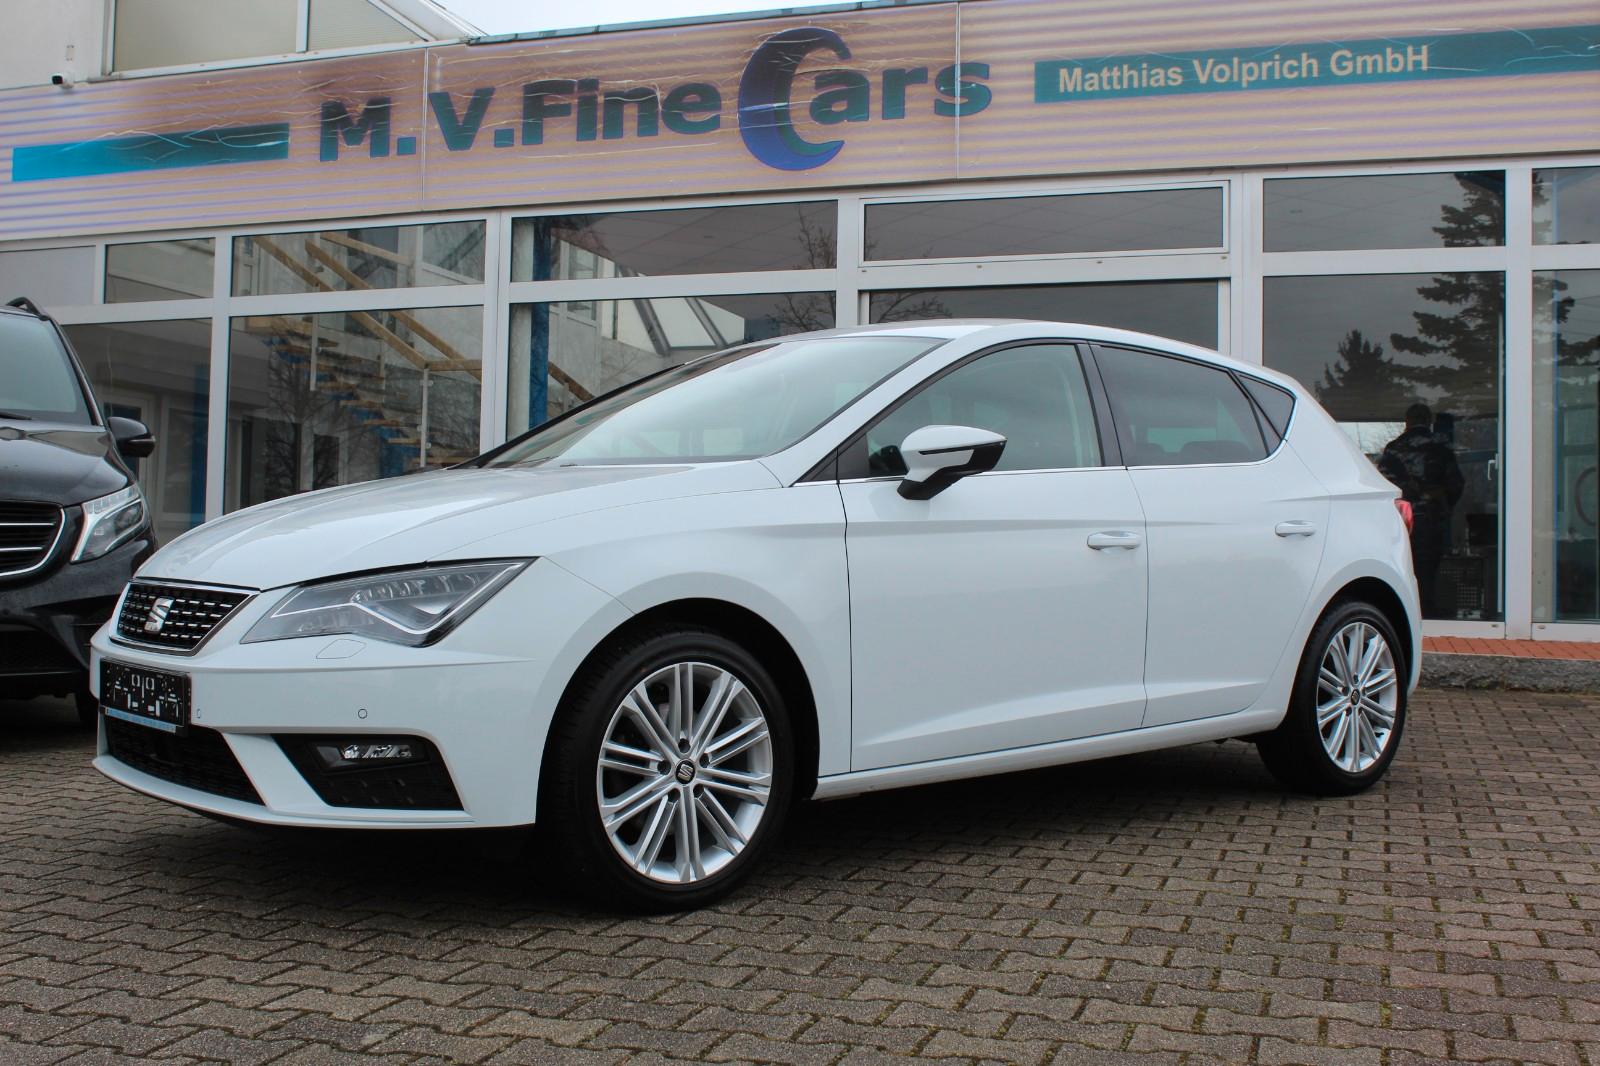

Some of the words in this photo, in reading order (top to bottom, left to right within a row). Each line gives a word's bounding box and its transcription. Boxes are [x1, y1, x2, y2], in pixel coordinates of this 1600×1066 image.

[738, 27, 992, 171] Cars
[1059, 63, 1184, 93] Matthias
[1192, 57, 1319, 88] Volprich
[1330, 45, 1428, 76] GmbH
